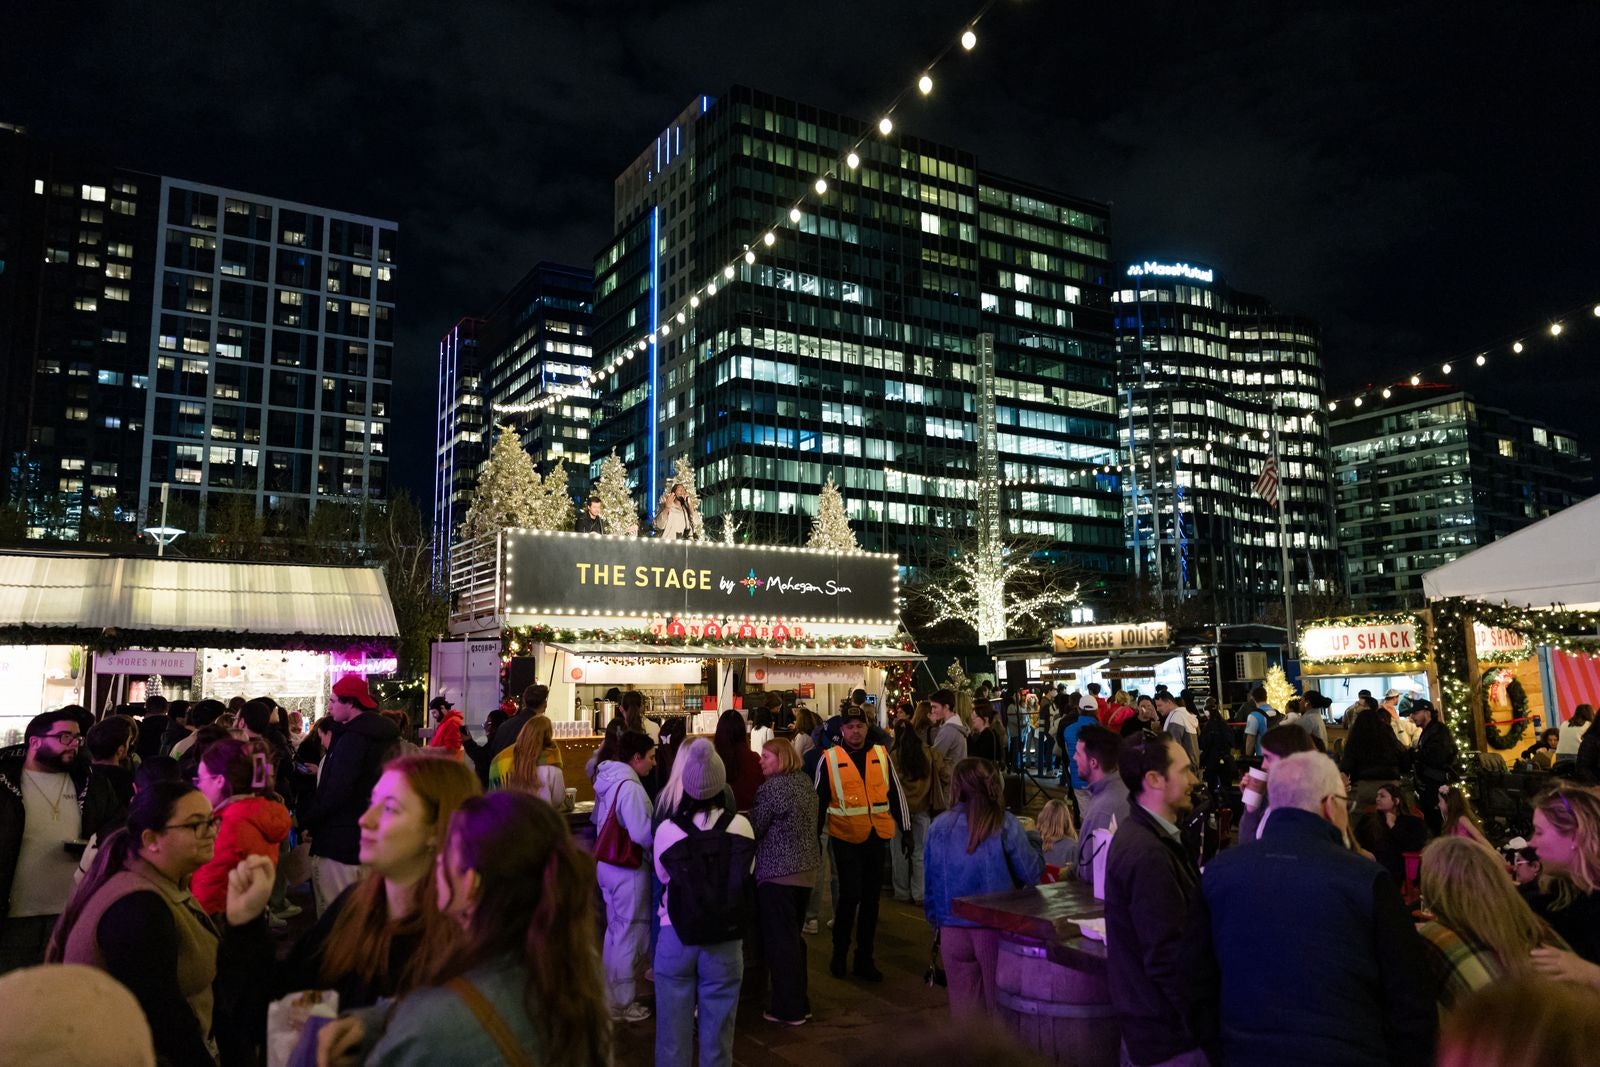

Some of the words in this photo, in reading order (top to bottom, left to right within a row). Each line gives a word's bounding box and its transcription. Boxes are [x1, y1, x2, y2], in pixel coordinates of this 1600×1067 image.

[576, 563, 626, 586] THE
[635, 566, 712, 590] STAGE
[719, 576, 736, 595] by
[766, 576, 823, 594] Mohegan
[825, 580, 852, 595] Sun
[1357, 631, 1410, 649] SHACK
[108, 657, 147, 667] S'MORES
